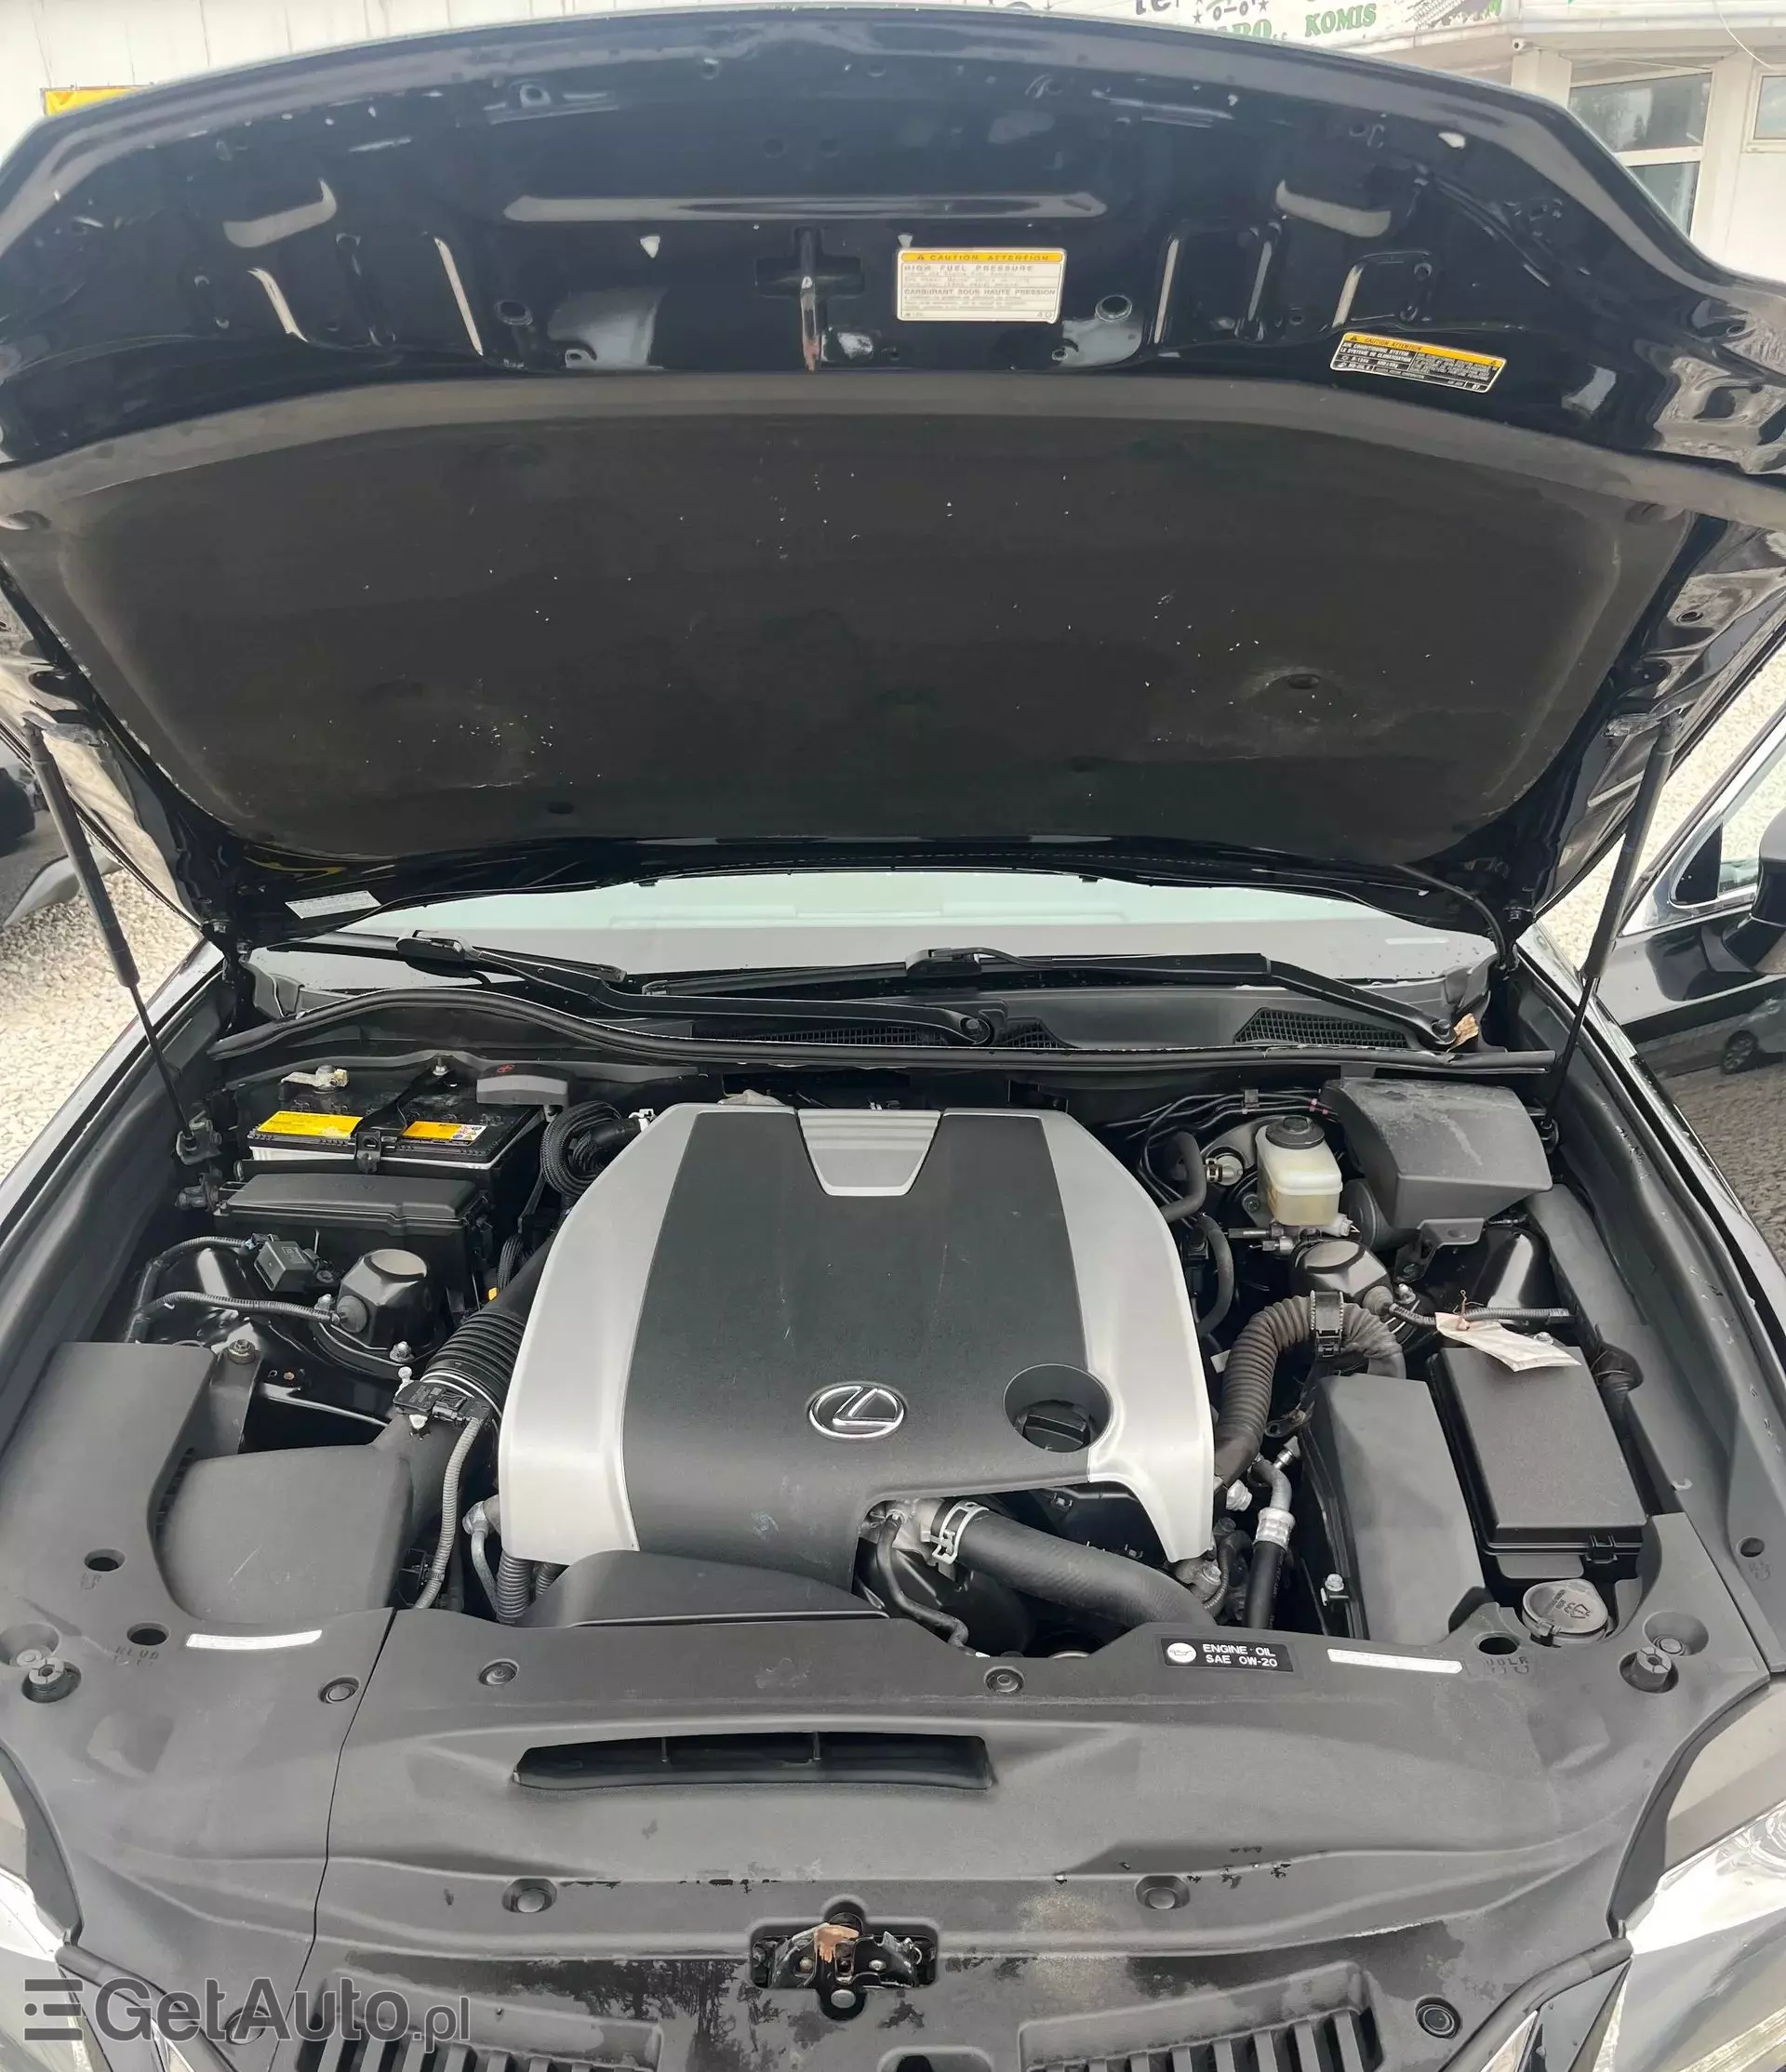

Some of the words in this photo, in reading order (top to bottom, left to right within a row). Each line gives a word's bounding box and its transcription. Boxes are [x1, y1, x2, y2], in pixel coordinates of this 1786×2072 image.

[1304, 3, 1377, 38] KOMIS
[1202, 1643, 1248, 1654] ENGINE
[1255, 1646, 1276, 1657] OIL
[1206, 1654, 1232, 1665] SAE
[1238, 1655, 1278, 1667] 0W-20
